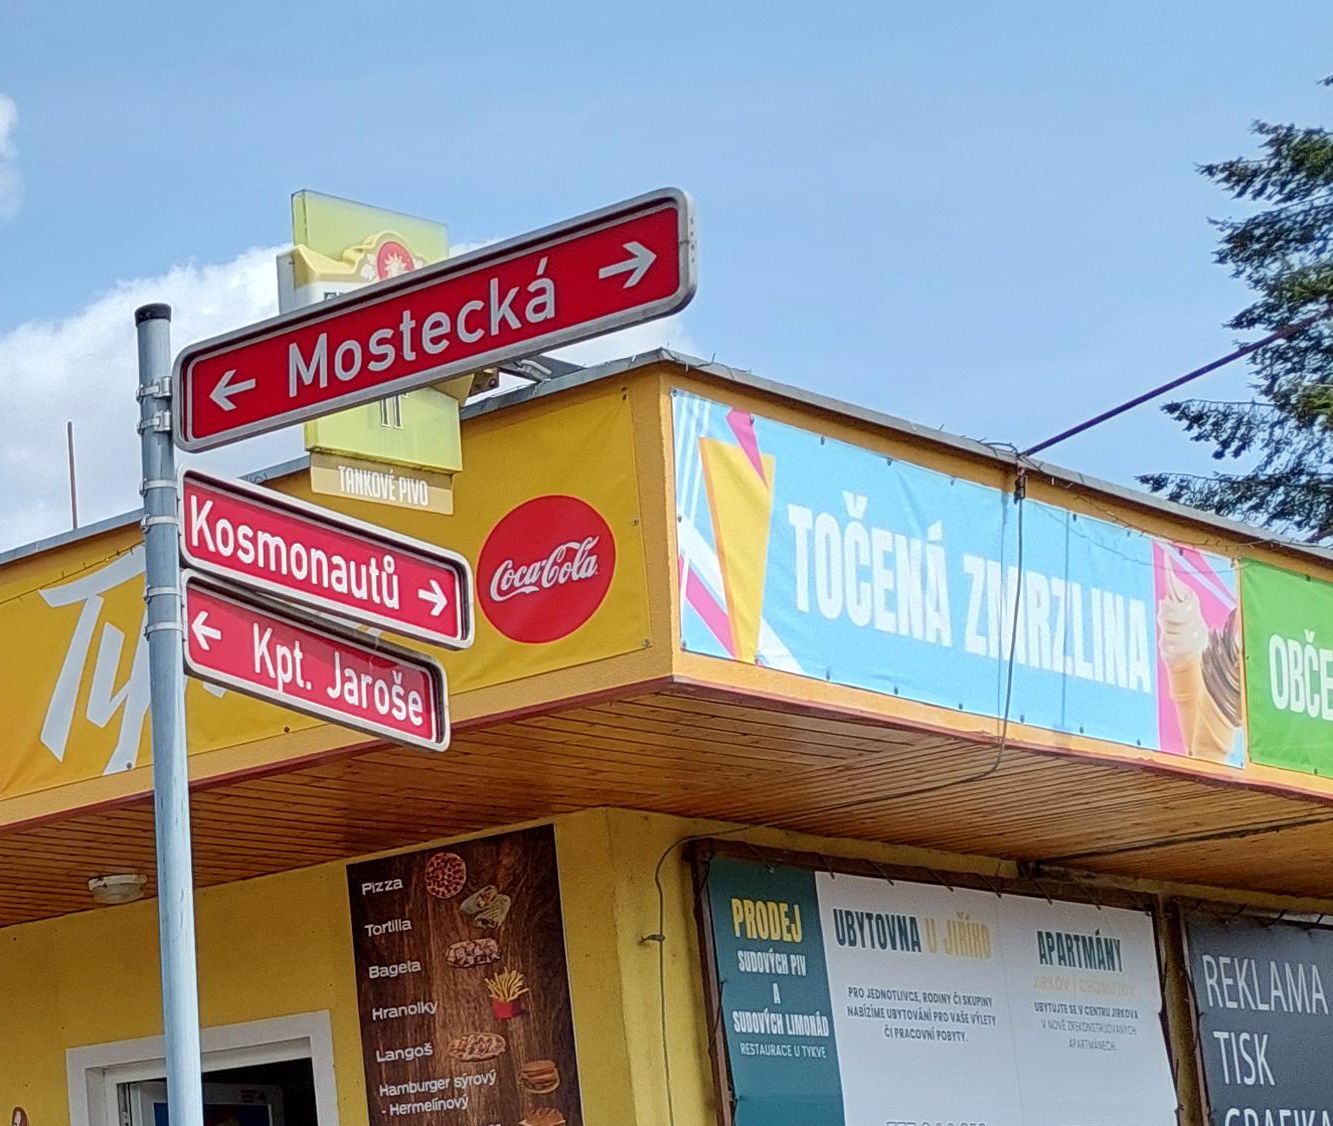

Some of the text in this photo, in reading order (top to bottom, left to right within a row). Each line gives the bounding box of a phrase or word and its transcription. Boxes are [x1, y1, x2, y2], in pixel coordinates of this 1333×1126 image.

[287, 257, 556, 397] Mostecká
[338, 465, 429, 507] TANKOVÉ PIVO
[190, 495, 401, 611] Kosmonautů
[490, 536, 599, 602] Coca-Cola
[787, 491, 1153, 694] TOČENÁ ZMRZLINA
[252, 621, 424, 727] Kpt. Jaroše
[361, 878, 404, 896] Pizza
[364, 919, 413, 937] Tortilla
[730, 897, 804, 944] PRODEJ
[832, 908, 922, 953] UBYTOVNA
[737, 947, 808, 977] SUDOVÝCH PIV
[1036, 928, 1123, 972] APARTMÁNY
[772, 982, 782, 1005] A
[848, 986, 994, 1008] PRO JEDNOTLIVCE, RODINY ČI SKUPINY
[1201, 954, 1330, 1016] REKLAMA
[372, 1001, 439, 1021] Hranolky
[732, 1007, 830, 1038] SUDOVÝCH LIMONÁD
[846, 1003, 998, 1027] NABÍZÍME UBYTOVÁNÍ PRO VAŠE VÝLETY
[884, 1024, 894, 1038] ČI
[894, 1026, 936, 1041] PRACOVNÍ
[375, 1041, 434, 1063] Langoš
[739, 1042, 828, 1059] RESTAURACE U TYKVE
[1212, 1030, 1276, 1087] TISK
[379, 1068, 497, 1097] Hamburger sýrový
[389, 1094, 470, 1117] Hermelínový
